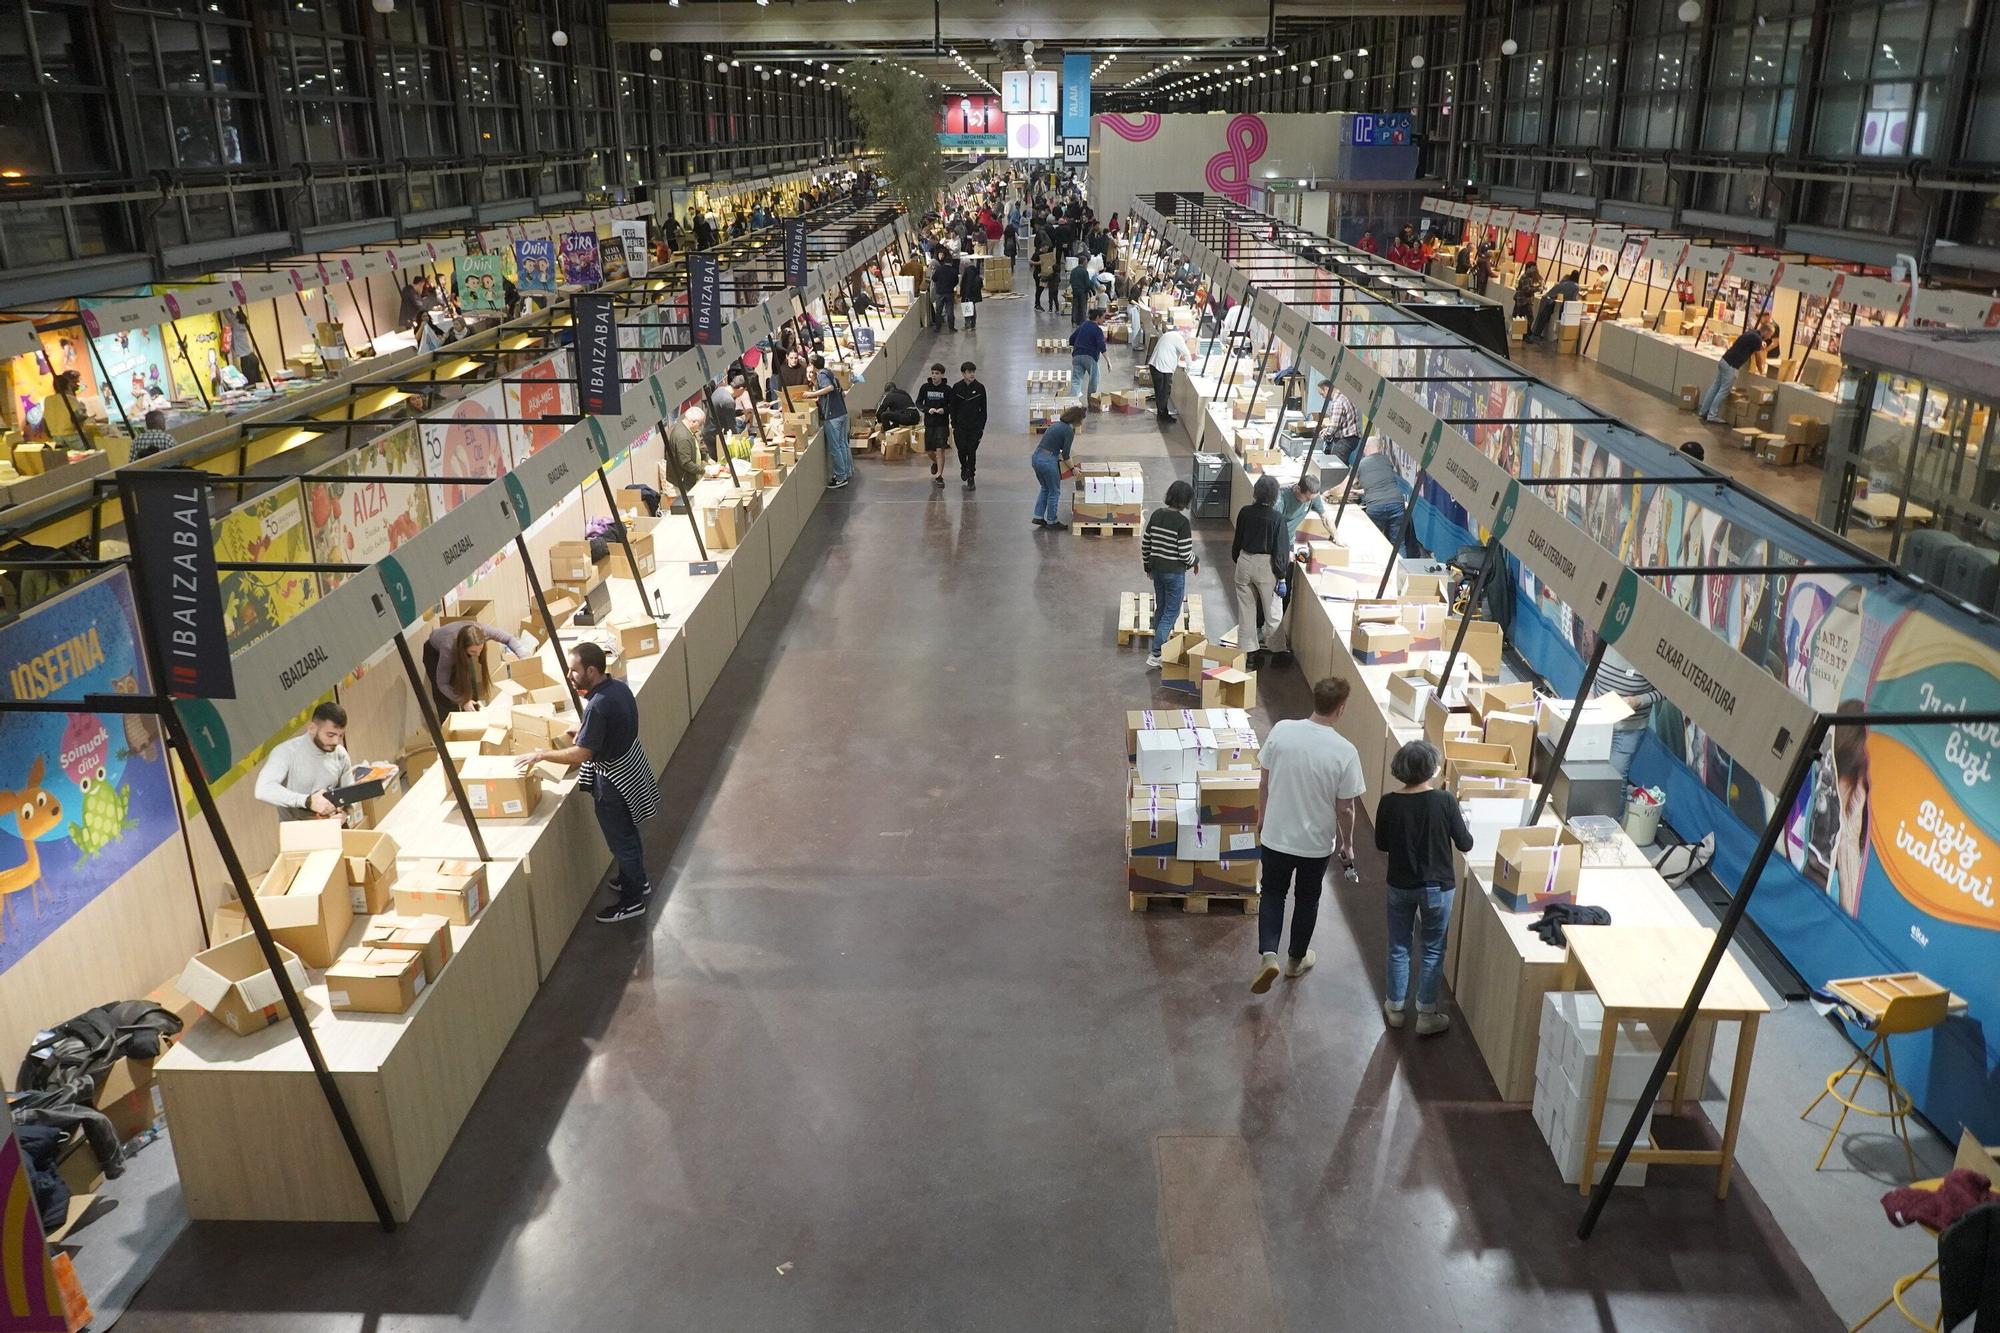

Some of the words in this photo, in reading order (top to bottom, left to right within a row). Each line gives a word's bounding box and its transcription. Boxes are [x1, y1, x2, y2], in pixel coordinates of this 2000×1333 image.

[1067, 144, 1086, 157] DA!
[790, 221, 805, 275] IBAIZABAL
[699, 258, 716, 330] IBAIZABAL
[590, 301, 611, 394] IBAIZABAL
[173, 487, 199, 658] IBAIZABAL
[442, 534, 474, 567] IBAIZABAL
[1527, 529, 1547, 554] ELKAR
[1545, 543, 1576, 581] LITERATURA
[395, 582, 408, 602] 2
[1615, 602, 1630, 626] 81
[279, 644, 329, 692] IBAIZABAL
[1656, 638, 1683, 670] ELKAR
[1681, 662, 1737, 717] LITERATURA
[59, 725, 110, 770] Soinuak
[202, 729, 216, 749] 1
[1916, 800, 1982, 870] Biziz
[1895, 820, 1995, 908] irakurri
